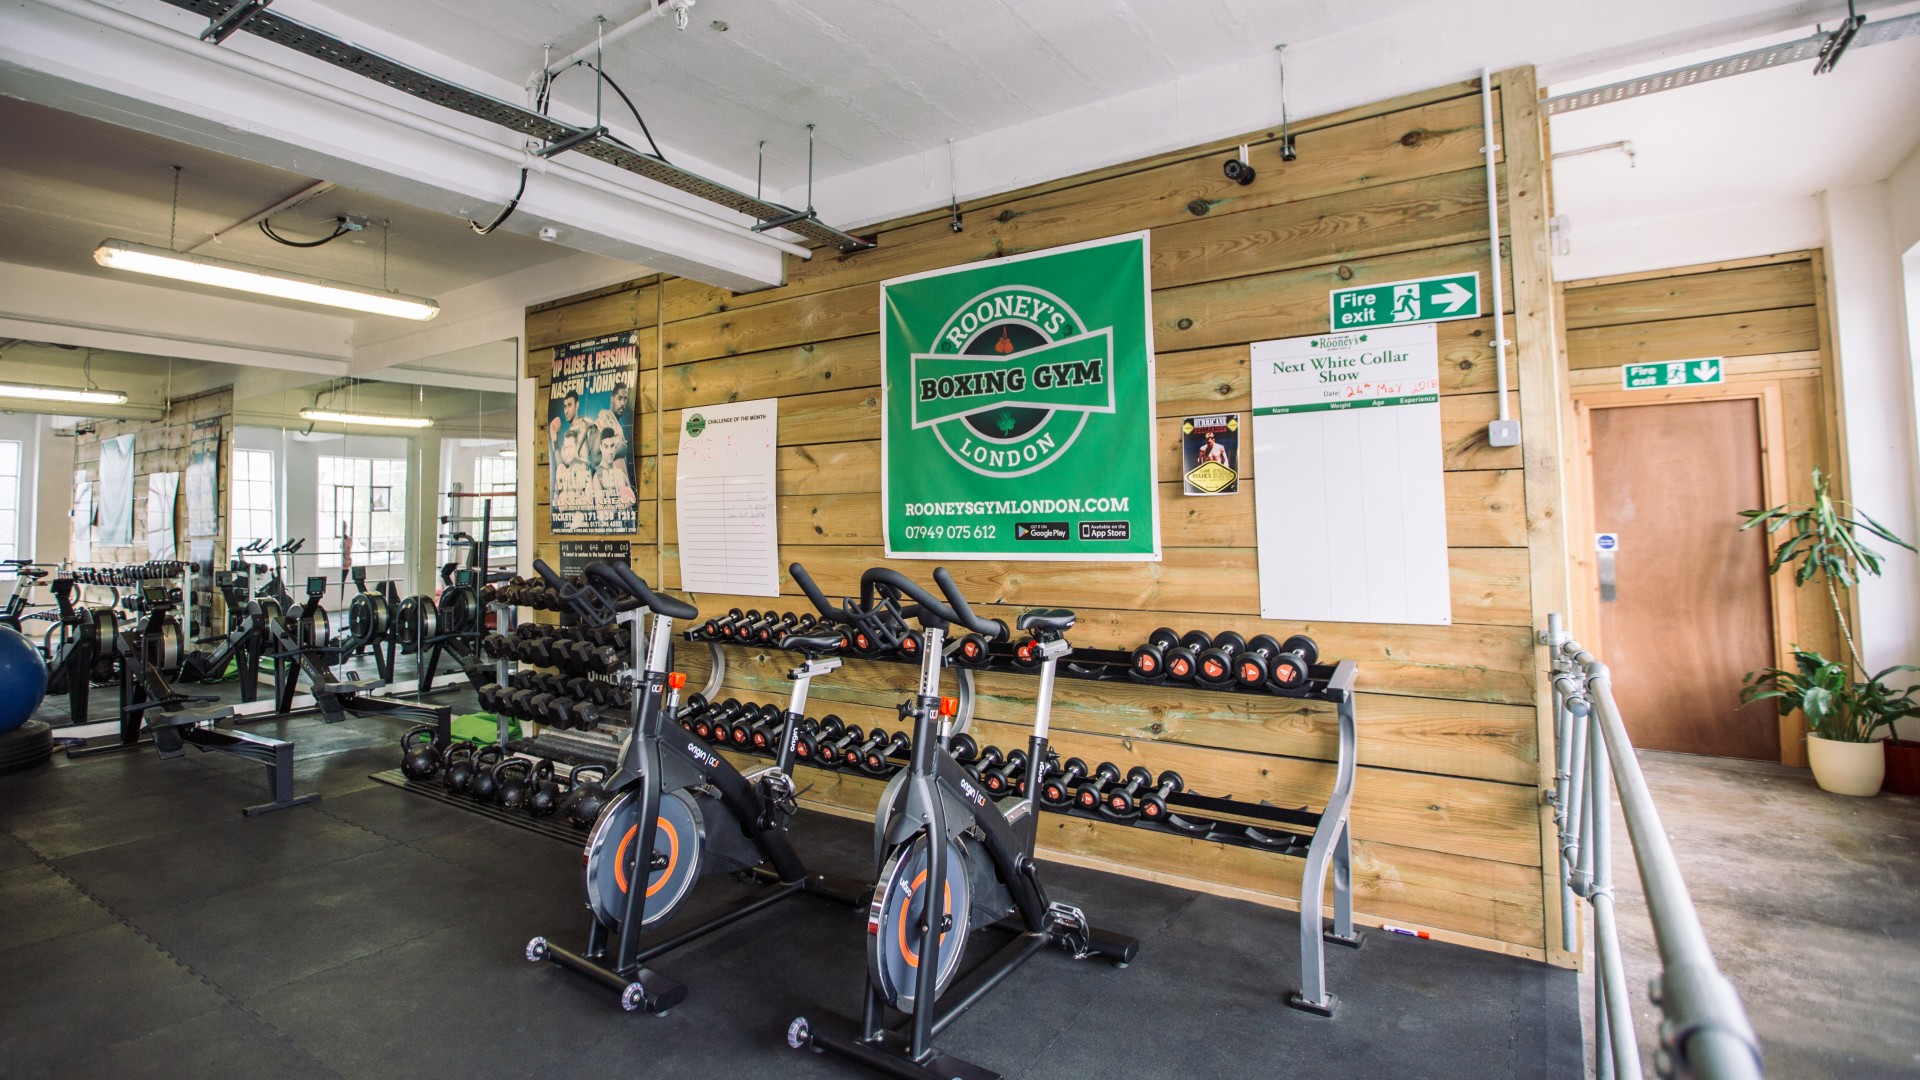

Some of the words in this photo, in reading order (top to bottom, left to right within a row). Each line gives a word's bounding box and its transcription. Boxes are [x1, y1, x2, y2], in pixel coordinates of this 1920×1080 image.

[1340, 293, 1377, 309] Fire
[945, 294, 1066, 349] ROONEY'S
[1341, 308, 1376, 324] exit
[1319, 336, 1358, 349] Rooney's
[552, 359, 562, 378] UP
[563, 354, 586, 376] CLOSE
[587, 353, 593, 372] &
[595, 346, 637, 370] PERSONAL
[1272, 361, 1305, 374] Next
[1310, 354, 1357, 371] White
[1360, 350, 1409, 366] Collar
[1319, 371, 1360, 384] Show
[1630, 366, 1657, 376] Fire
[550, 378, 584, 400] NASEEM
[590, 370, 635, 394] JOHNSON
[919, 367, 1026, 402] BOXING
[1032, 358, 1103, 390] GYM
[1411, 379, 1438, 395] 2018
[1631, 376, 1657, 386] exit
[1371, 399, 1385, 407] Age
[1400, 395, 1436, 404] Experience
[707, 417, 733, 425] CHALLENGE
[959, 432, 1057, 468] LONDON
[905, 497, 1129, 517] ROONEYSGYMLONDON.COM
[905, 526, 944, 539] 07949
[946, 525, 971, 539] 075
[973, 525, 996, 539] 612
[1030, 529, 1053, 539] Google
[1053, 529, 1066, 538] Play
[1091, 530, 1107, 538] App
[1107, 529, 1127, 537] Store
[790, 727, 799, 752] origin
[687, 742, 707, 761] origin
[960, 778, 976, 799] origin
